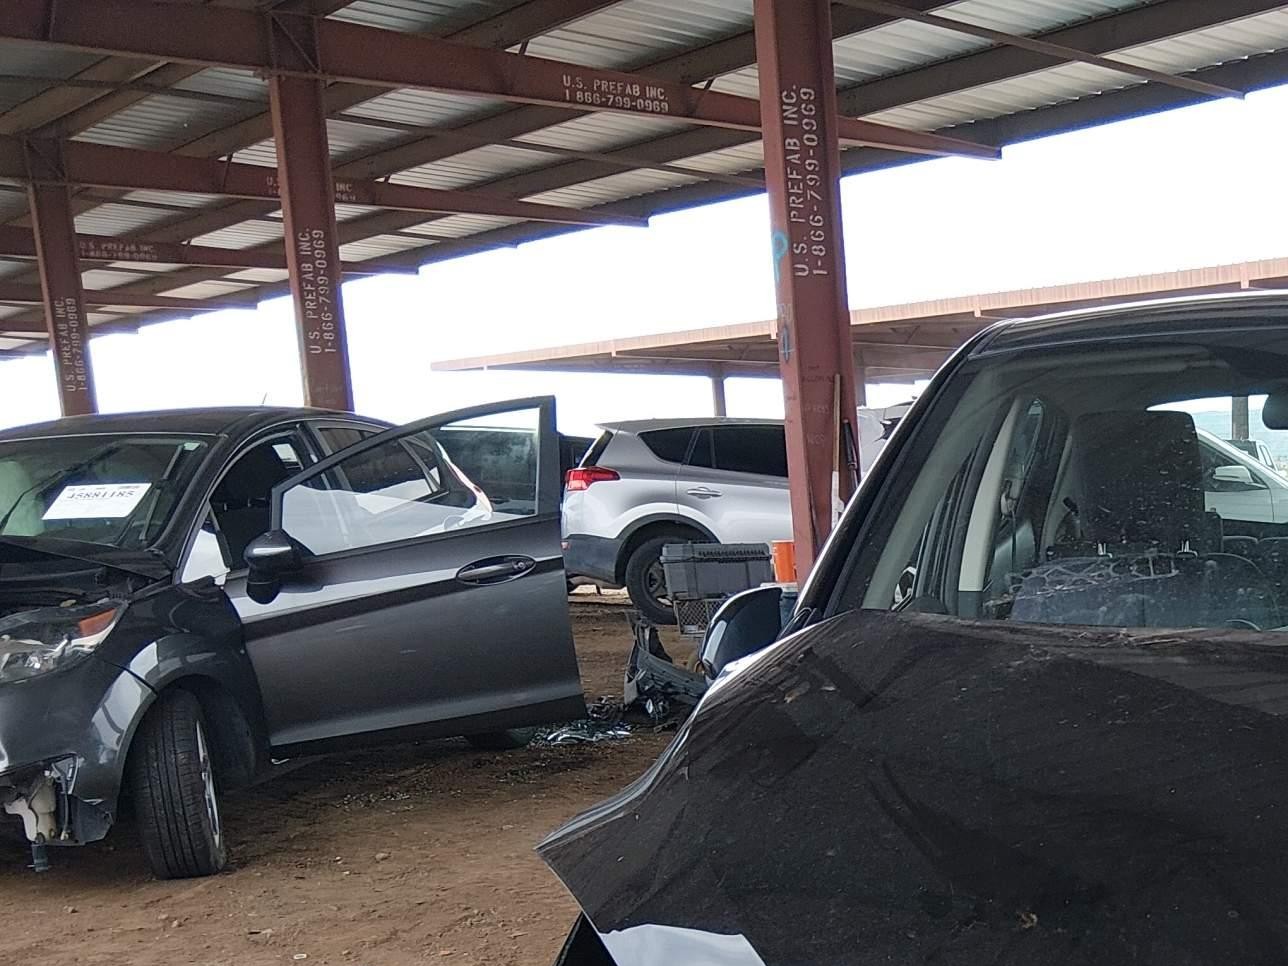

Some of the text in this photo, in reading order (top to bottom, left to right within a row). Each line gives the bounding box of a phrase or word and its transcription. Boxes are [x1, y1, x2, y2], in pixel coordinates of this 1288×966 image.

[562, 74, 669, 101] U.S. PREFAB INC.
[781, 84, 810, 277] U.S. PREFAB INC.
[800, 87, 828, 276] 1-866-799-0969
[298, 227, 311, 256] INC.
[301, 264, 319, 319] PREFAB
[311, 229, 337, 353] 1-866-799-0969
